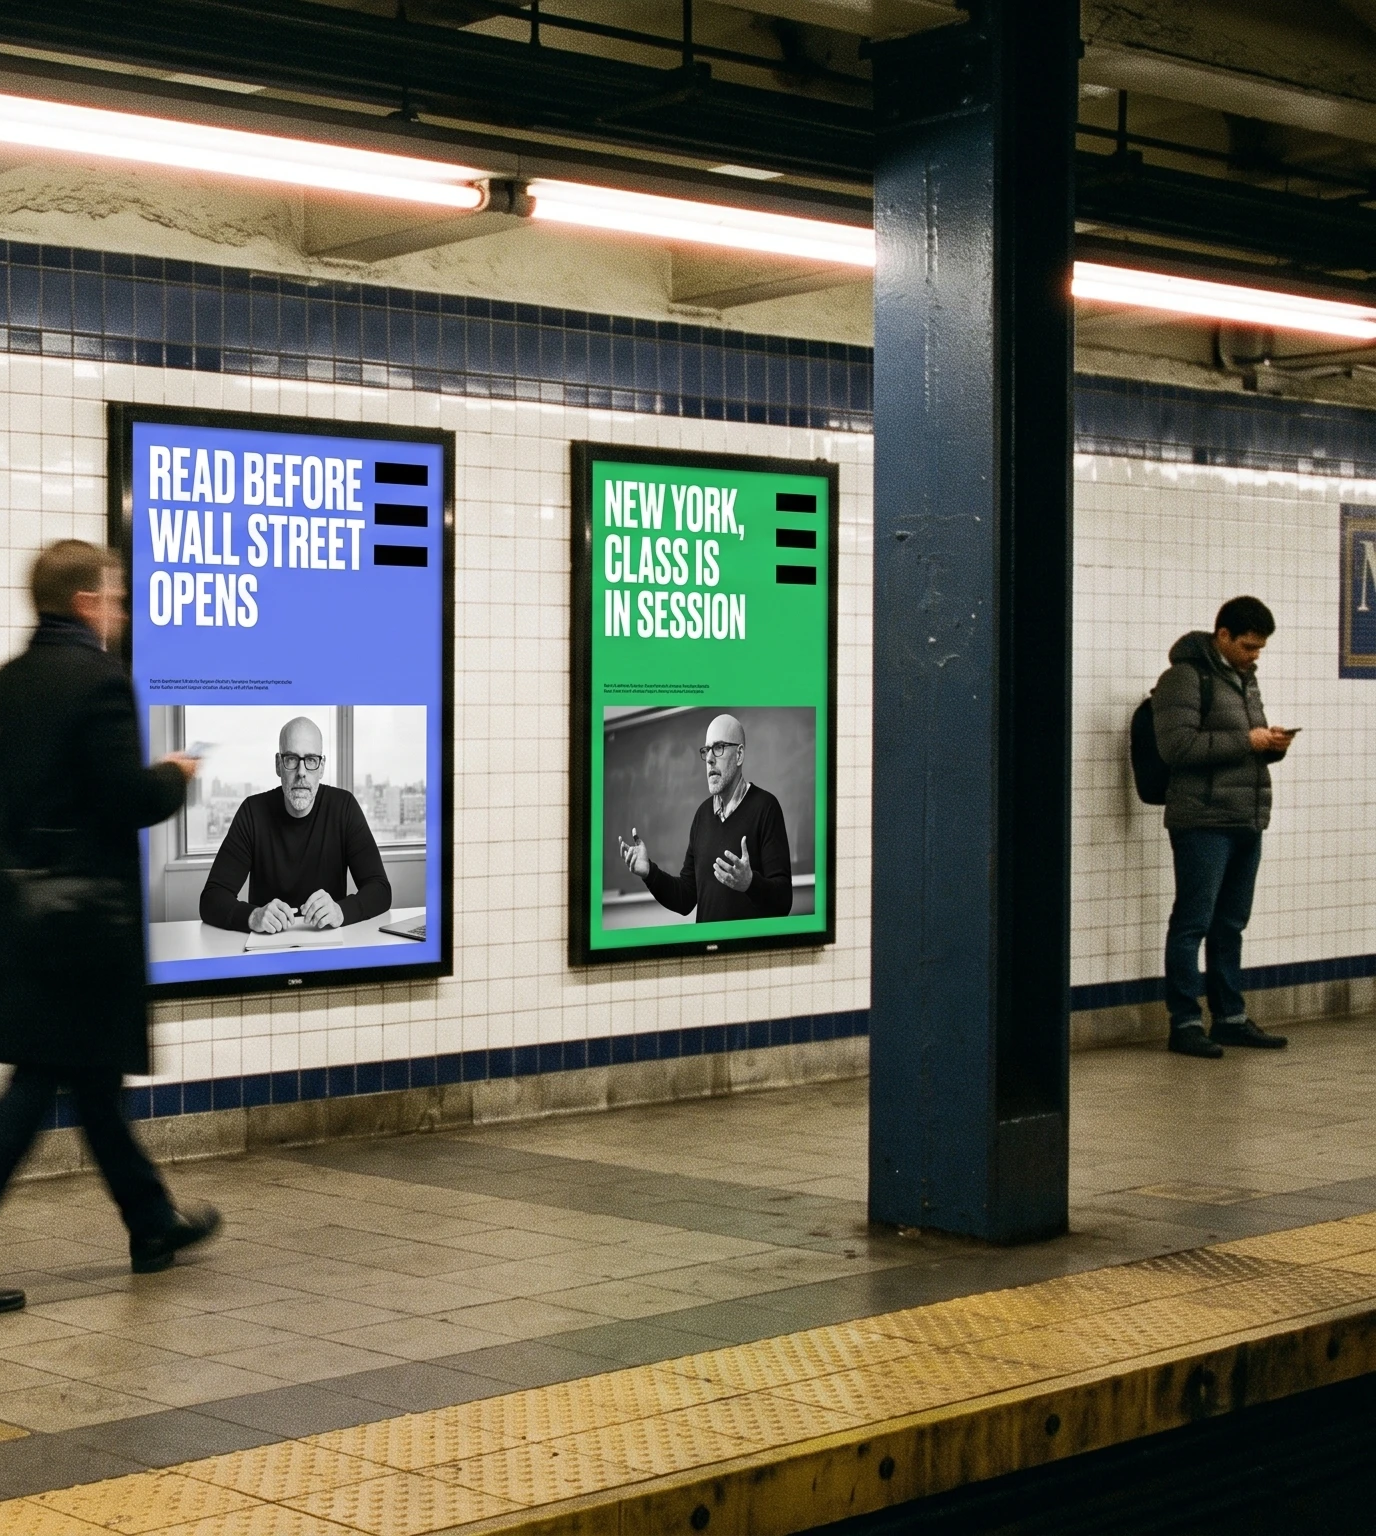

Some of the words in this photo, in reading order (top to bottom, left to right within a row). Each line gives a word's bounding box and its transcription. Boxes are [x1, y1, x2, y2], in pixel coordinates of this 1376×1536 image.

[150, 445, 236, 504] READ
[243, 451, 364, 512] BEFORE
[149, 508, 240, 566] WALL
[247, 512, 366, 571] STREET
[604, 479, 666, 530] NEW
[670, 485, 745, 541] YORK,
[604, 533, 689, 586] CLASS
[695, 539, 720, 587] IS
[149, 570, 259, 628] OPENS
[604, 589, 631, 638] IN
[637, 590, 746, 640] SESSION
